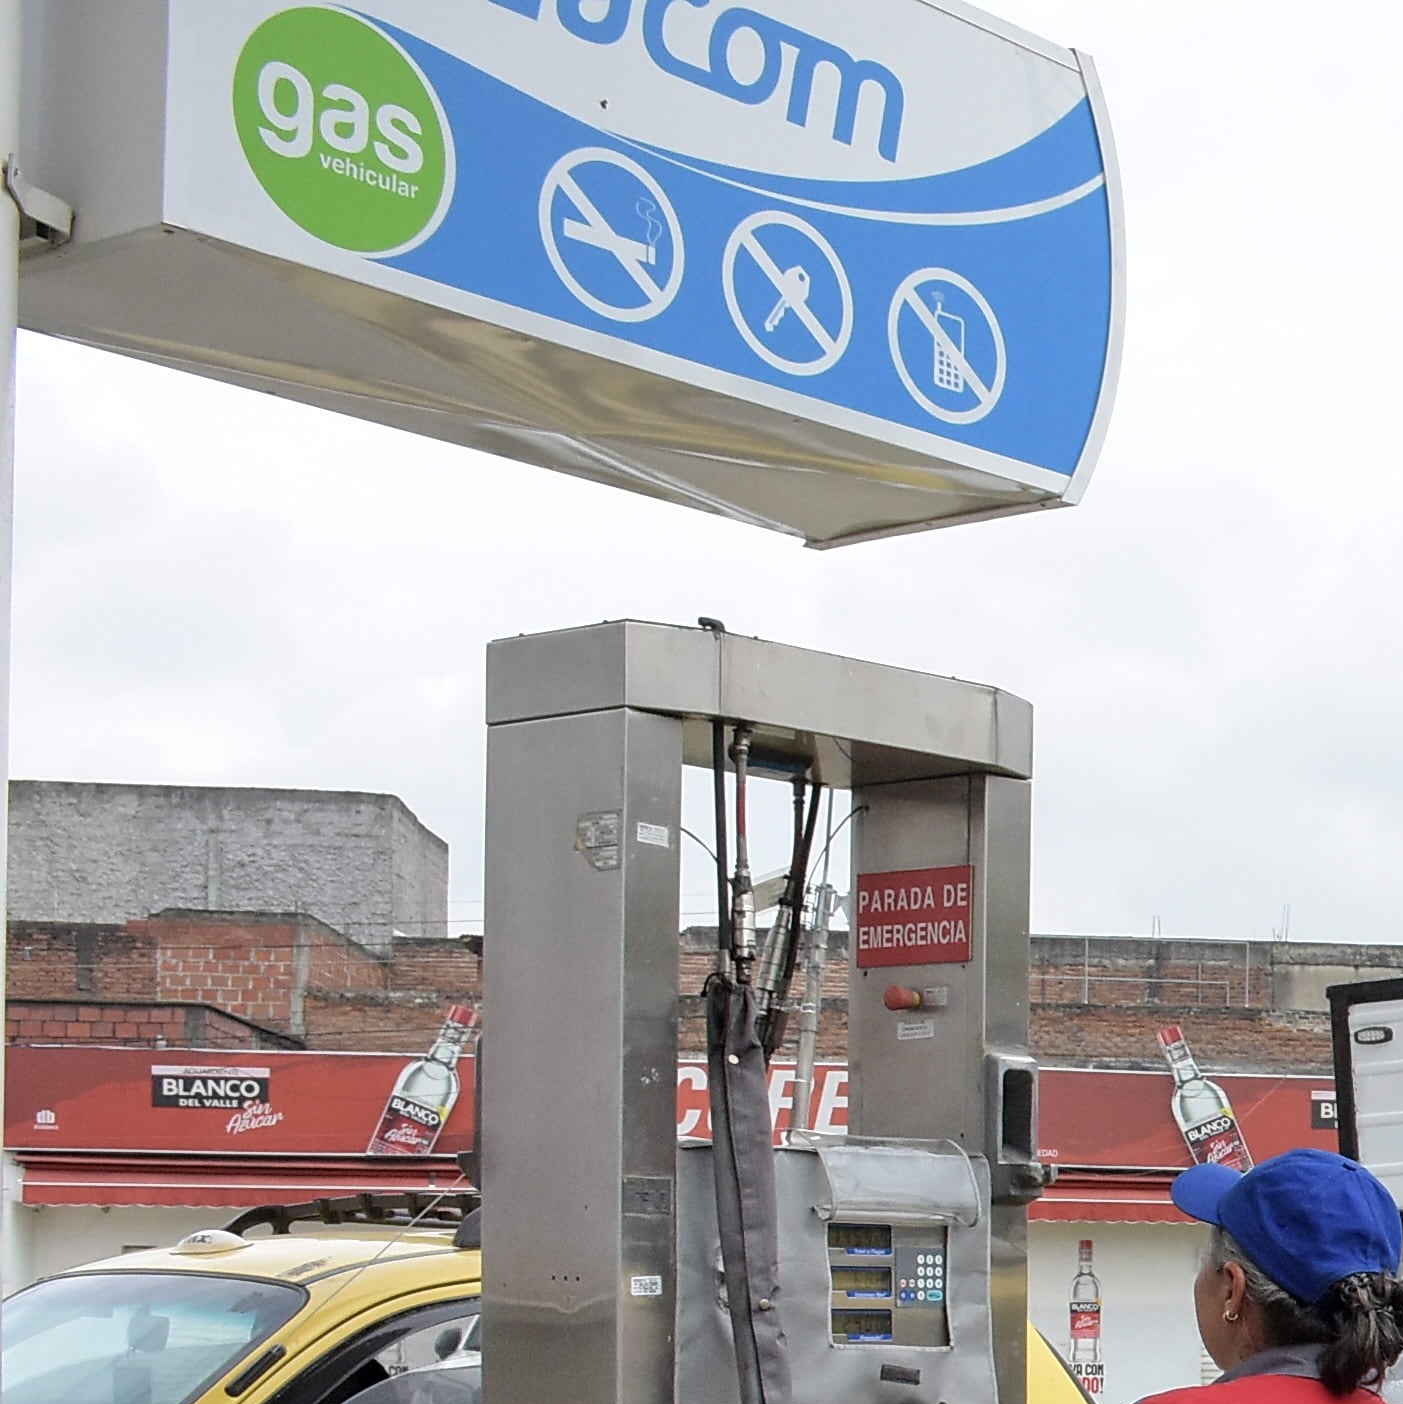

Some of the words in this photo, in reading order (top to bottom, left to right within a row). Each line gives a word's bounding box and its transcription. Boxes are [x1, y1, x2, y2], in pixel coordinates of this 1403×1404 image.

[257, 60, 424, 174] gas
[319, 153, 419, 199] vehicular
[859, 885, 935, 914] PARADA
[943, 883, 968, 907] DE
[858, 919, 967, 950] EMERGENCIA
[162, 1078, 260, 1098] BLANCO
[179, 1098, 200, 1107] DEL
[204, 1098, 239, 1108] VALLE
[243, 1099, 272, 1119] Sin
[391, 1098, 439, 1126] BLANCO
[1188, 1117, 1231, 1142] BLANCO
[1072, 1303, 1099, 1311] BLANCO
